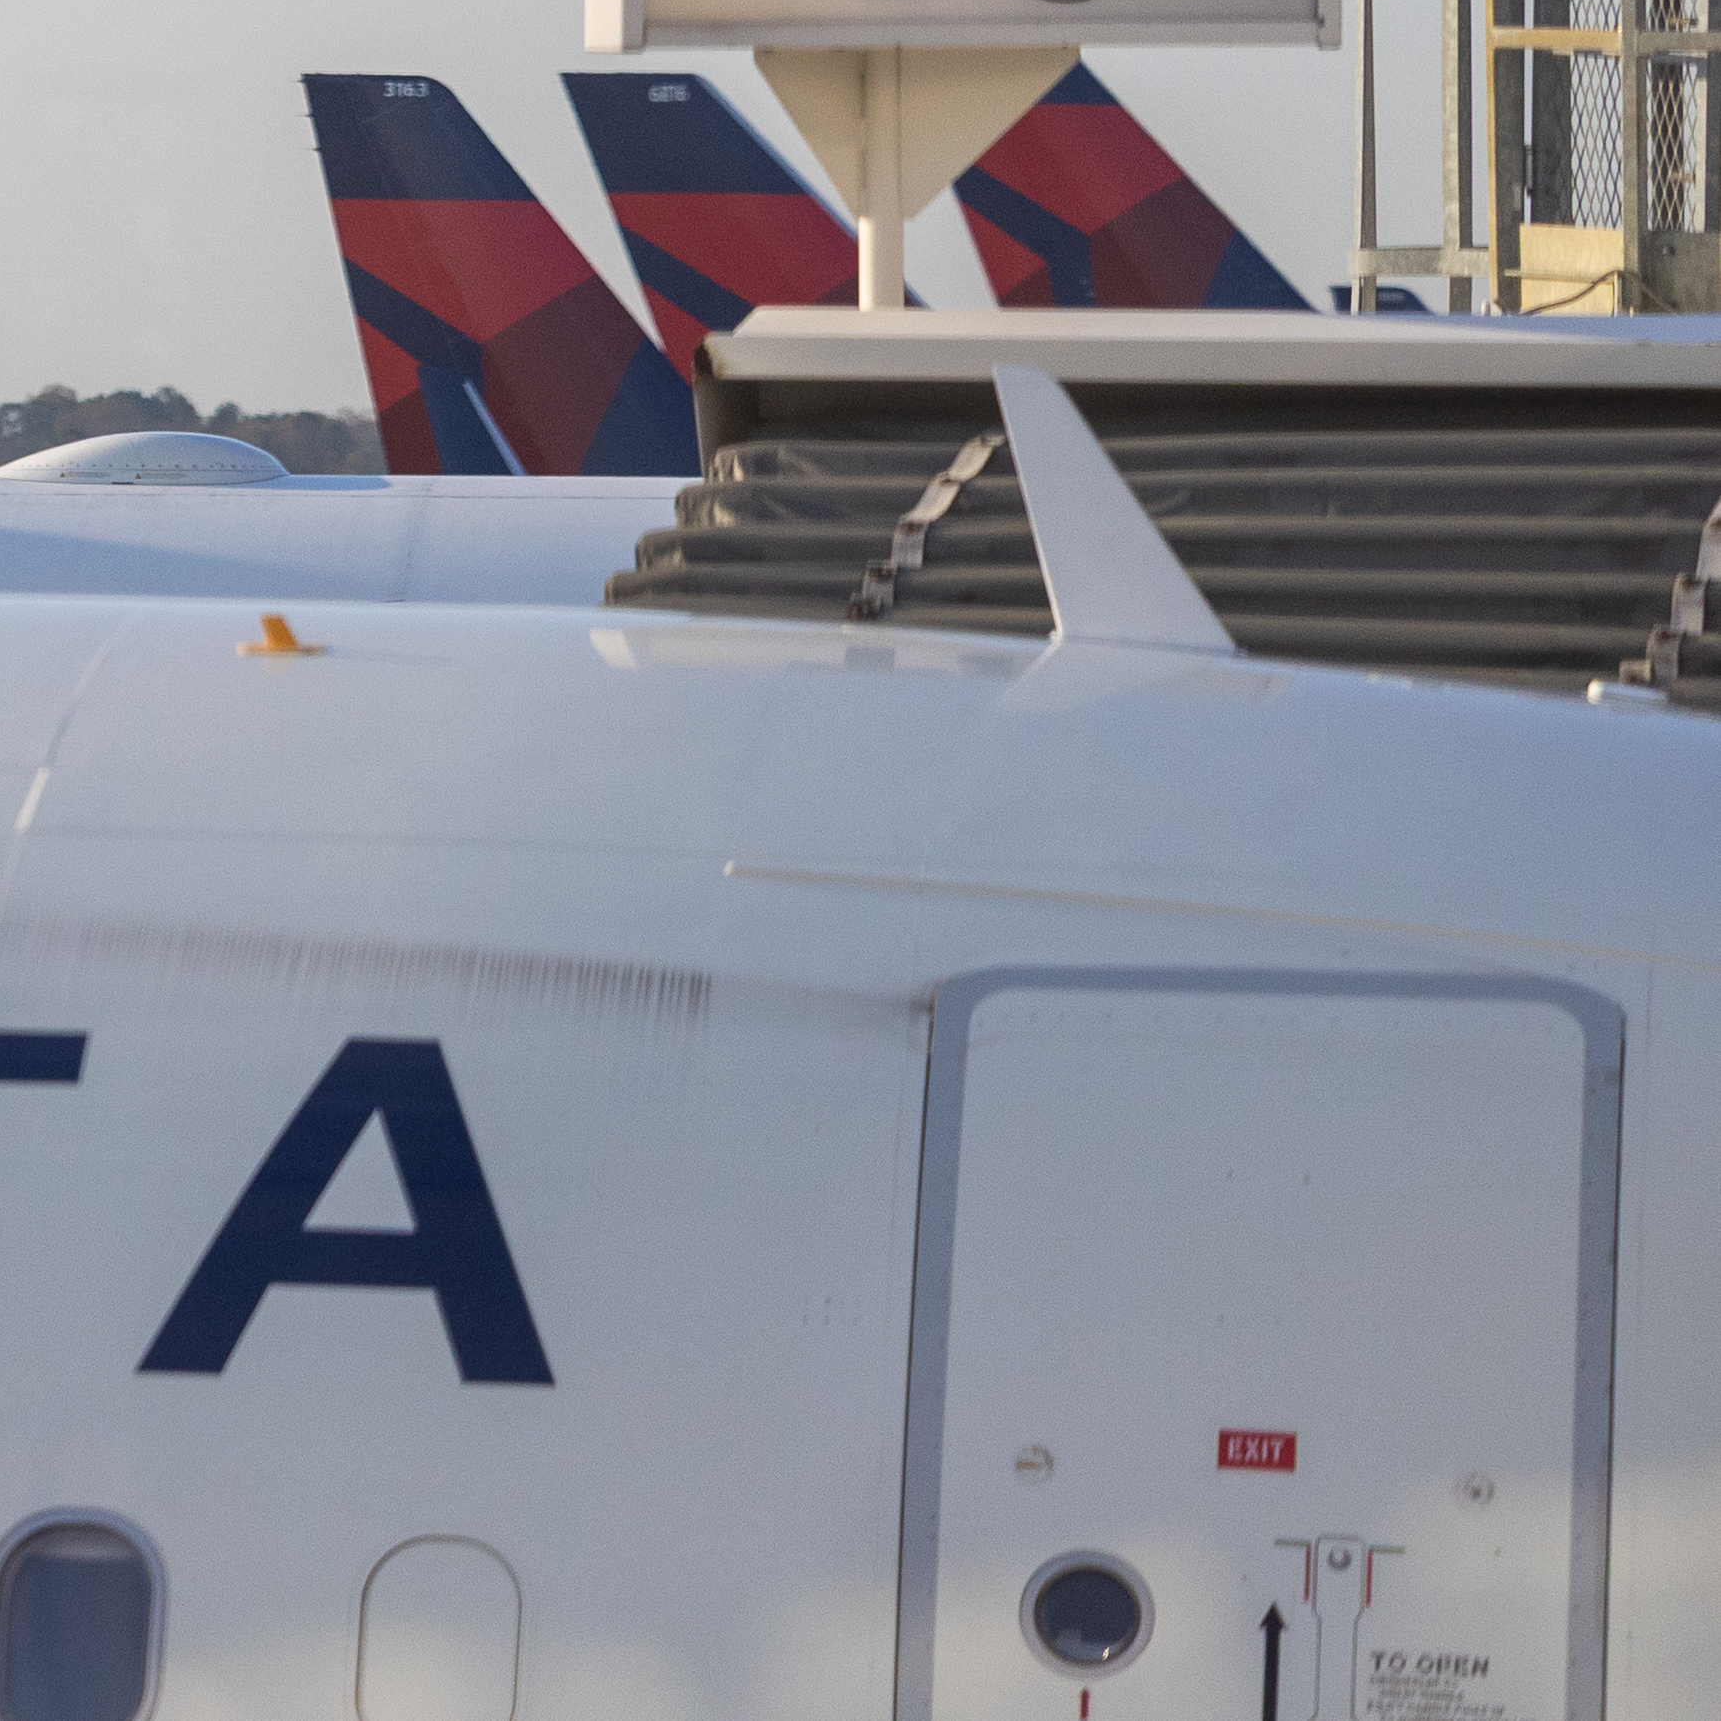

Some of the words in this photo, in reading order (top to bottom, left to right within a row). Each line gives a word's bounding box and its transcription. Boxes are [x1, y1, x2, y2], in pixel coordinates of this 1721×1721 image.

[1227, 1437, 1287, 1463] EXIT
[1370, 1649, 1408, 1675] TO
[1415, 1651, 1491, 1678] OPEN
